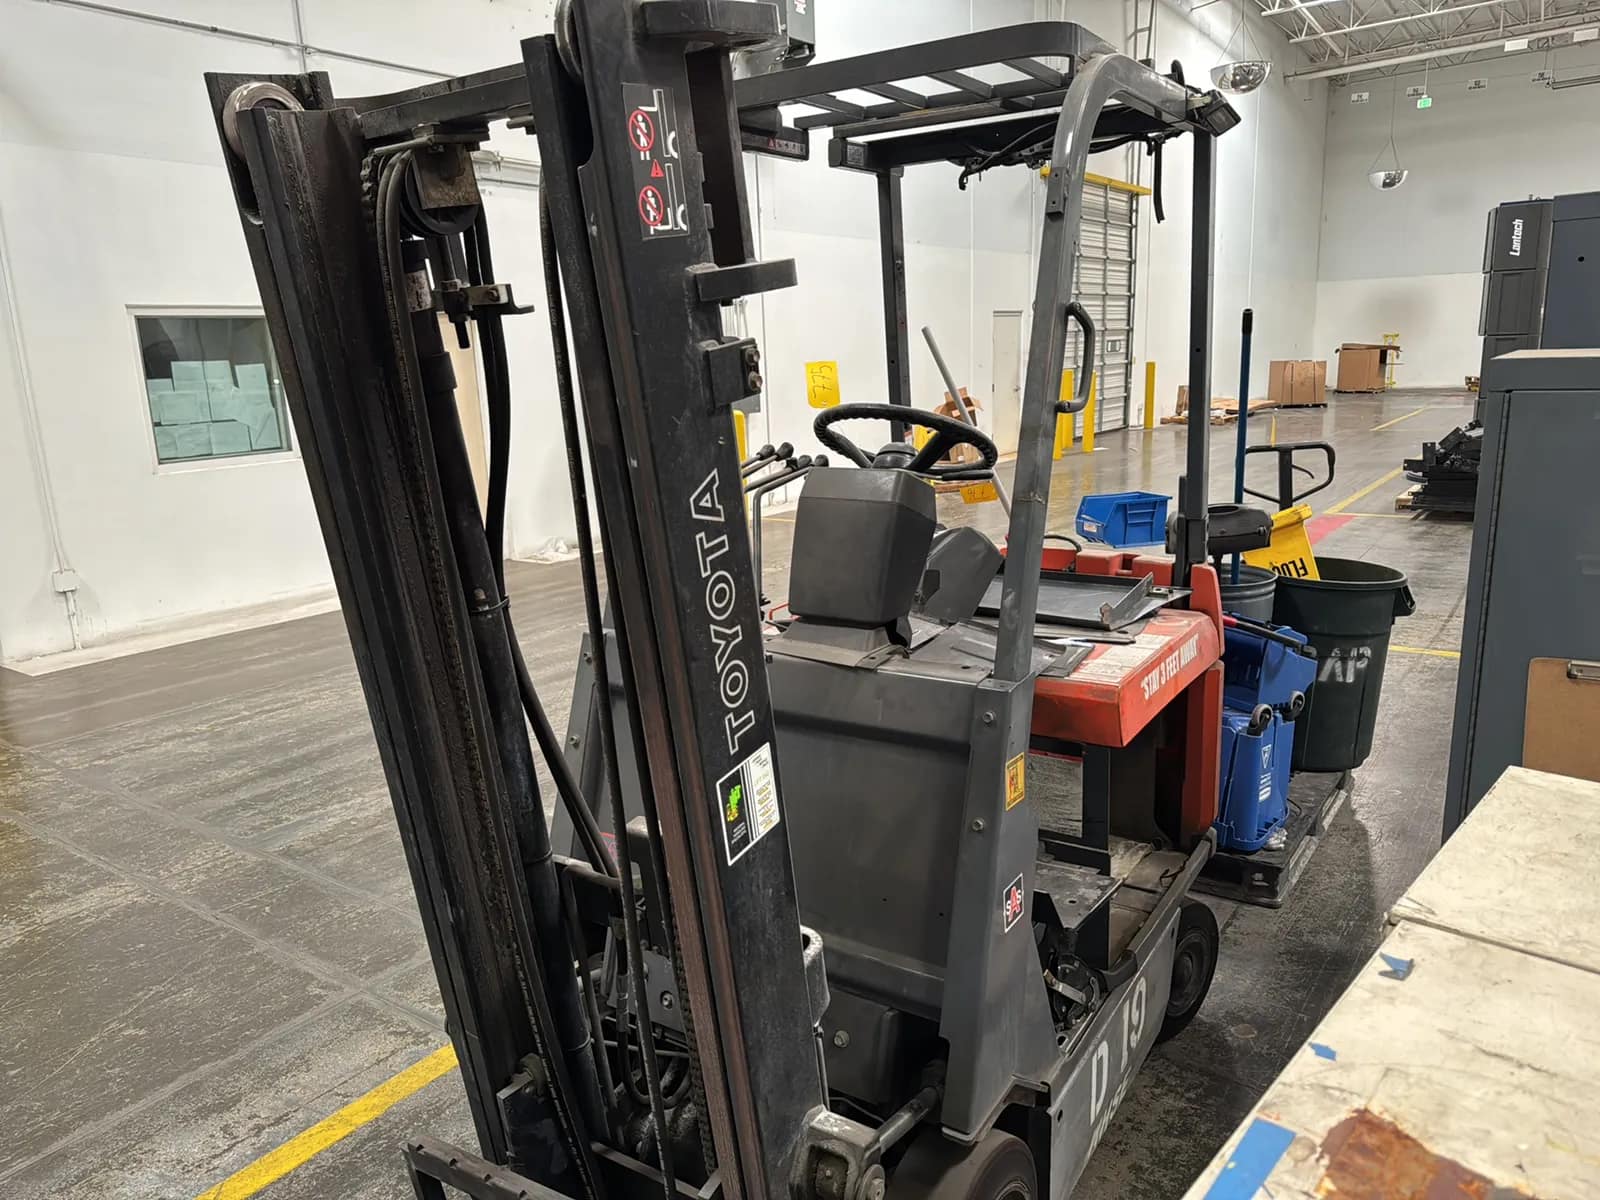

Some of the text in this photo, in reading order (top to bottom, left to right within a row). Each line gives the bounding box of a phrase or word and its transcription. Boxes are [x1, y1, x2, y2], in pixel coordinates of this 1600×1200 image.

[1509, 218, 1524, 256] Lantech
[689, 467, 756, 756] TOYOTA
[1160, 661, 1167, 686] 3
[1166, 649, 1180, 681] FEET
[1089, 976, 1147, 1127] D 19
